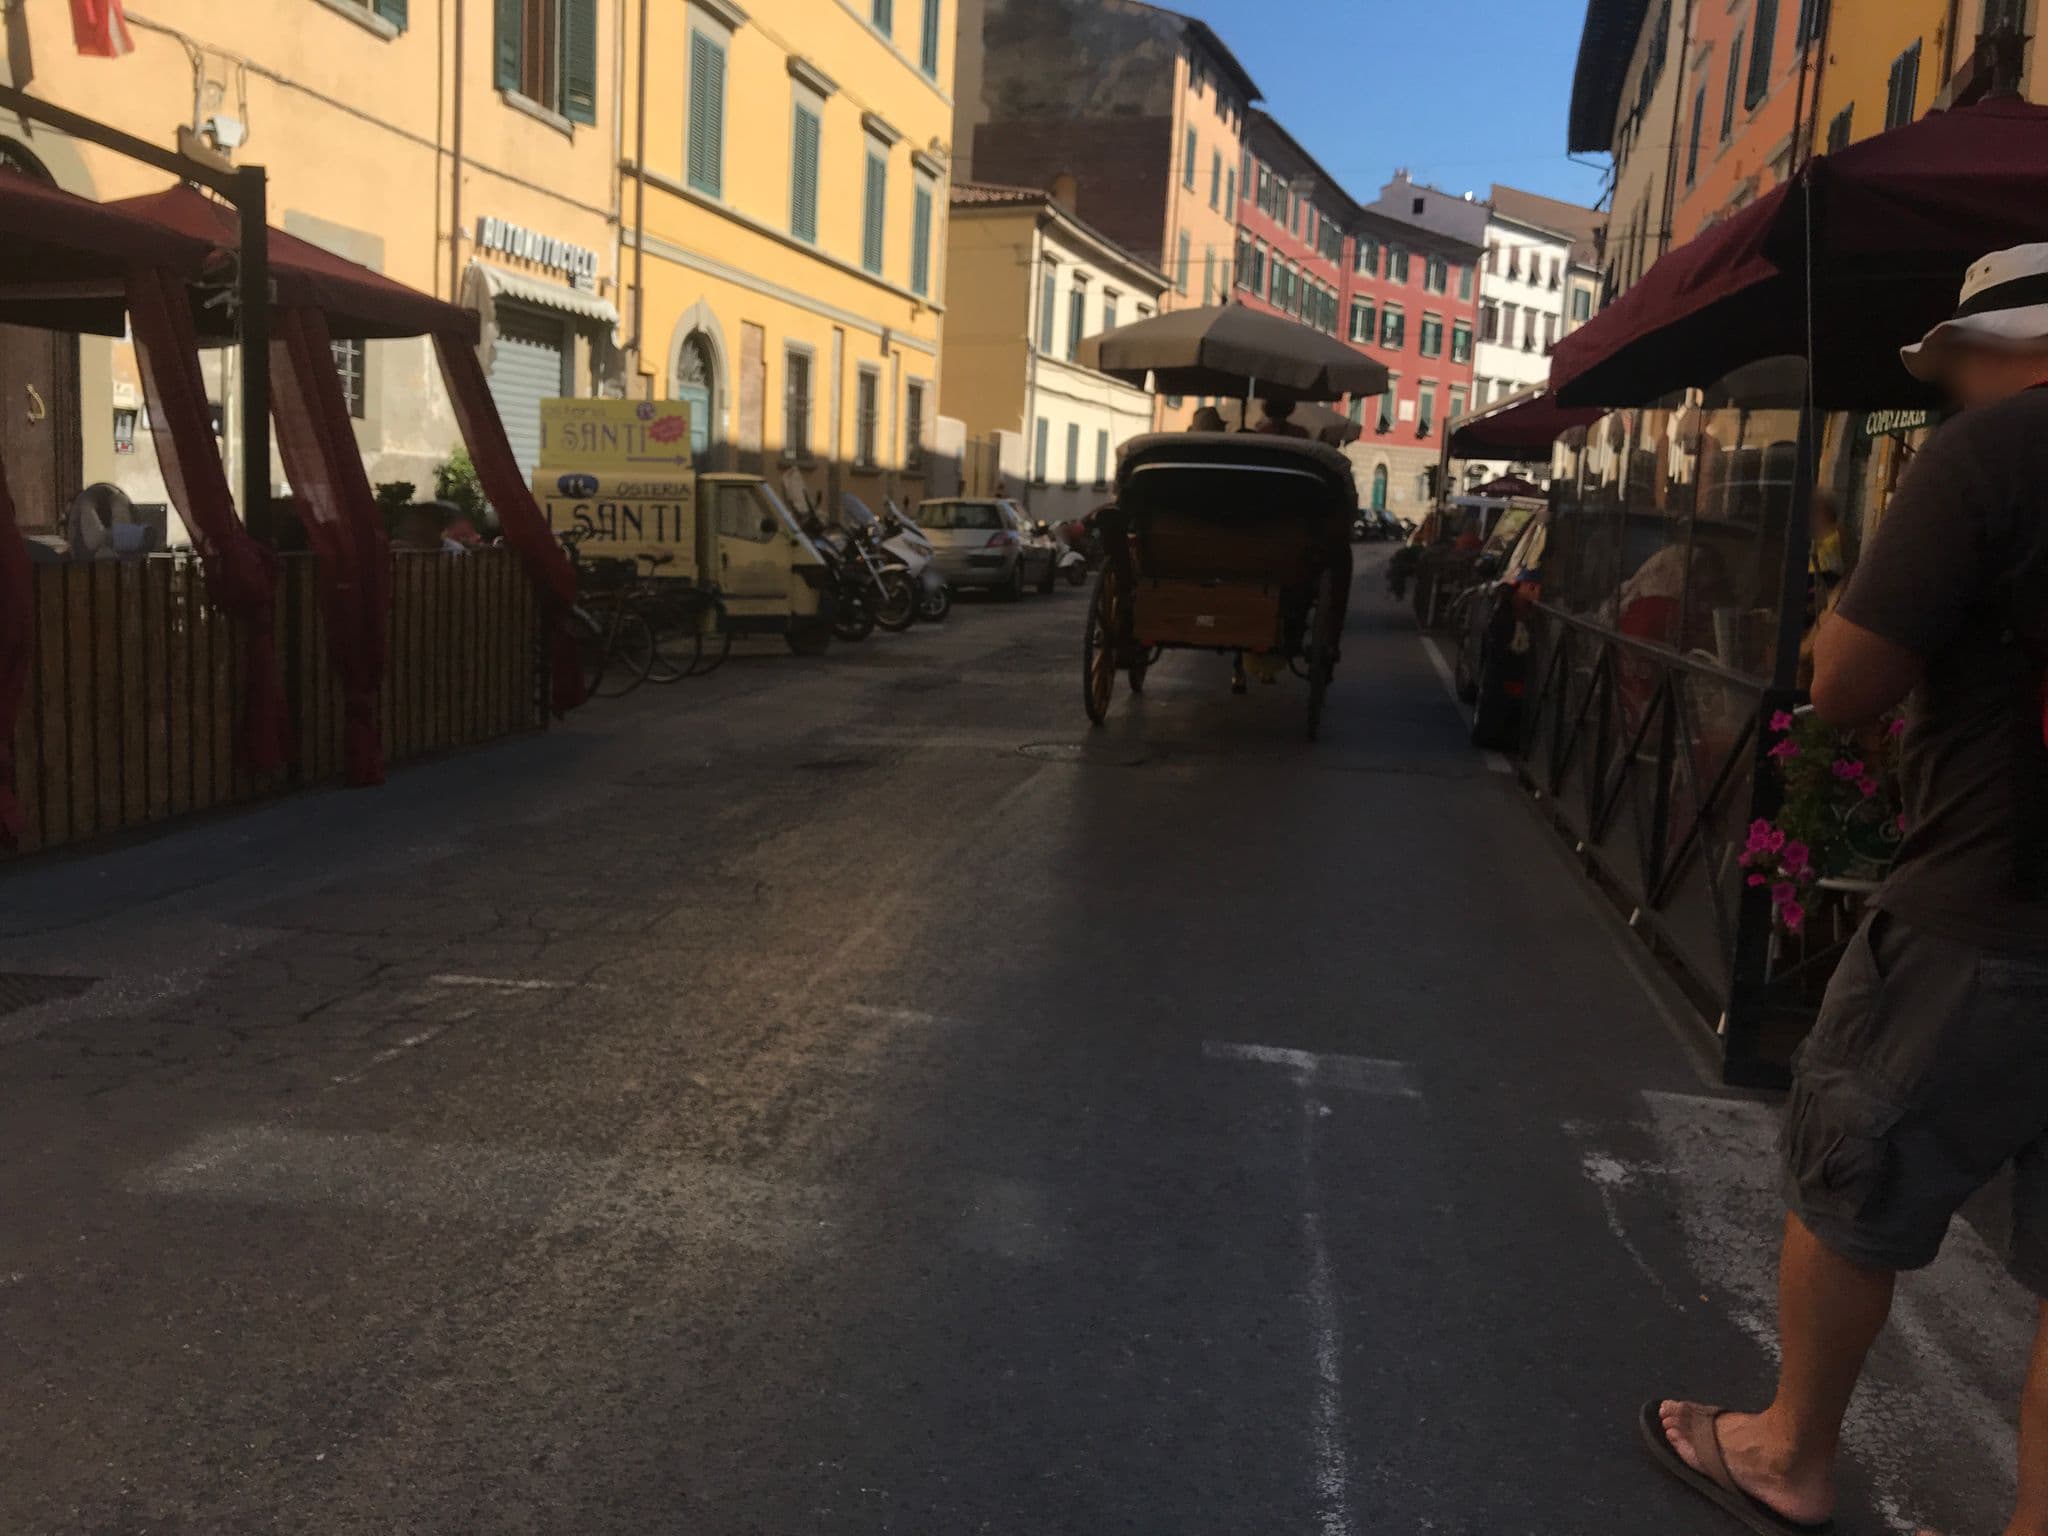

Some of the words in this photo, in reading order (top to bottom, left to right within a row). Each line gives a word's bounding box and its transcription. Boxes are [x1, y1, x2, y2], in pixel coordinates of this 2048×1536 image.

[561, 422, 646, 454] SANTI
[616, 481, 690, 497] OSTERIA
[573, 503, 682, 543] SANTI
